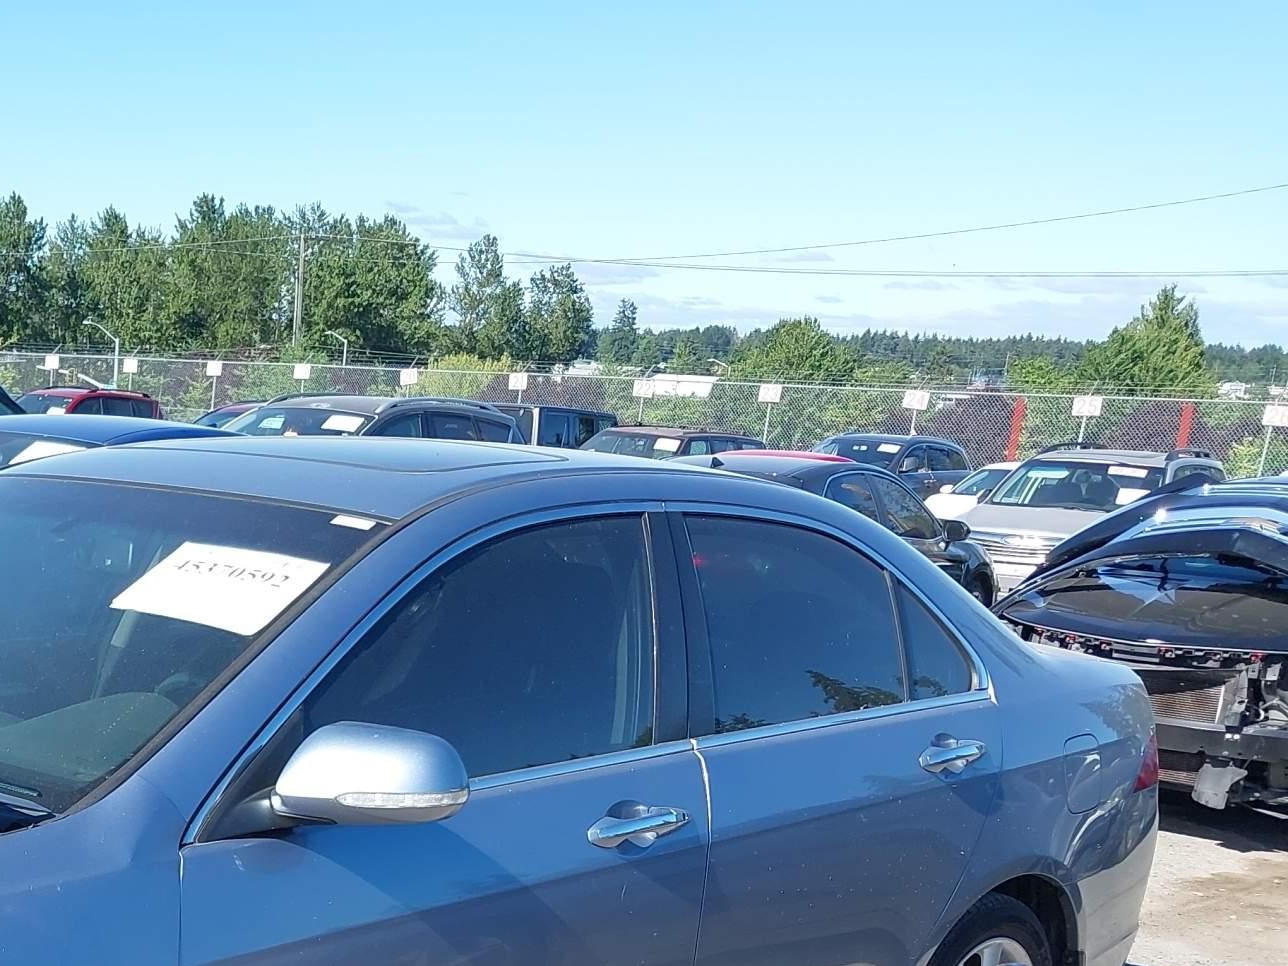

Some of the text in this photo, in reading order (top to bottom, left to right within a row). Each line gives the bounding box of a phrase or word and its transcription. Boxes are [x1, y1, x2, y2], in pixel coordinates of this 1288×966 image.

[636, 381, 651, 396] 22
[906, 391, 925, 408] 24
[1077, 397, 1096, 415] 25
[174, 560, 291, 588] 45370592
